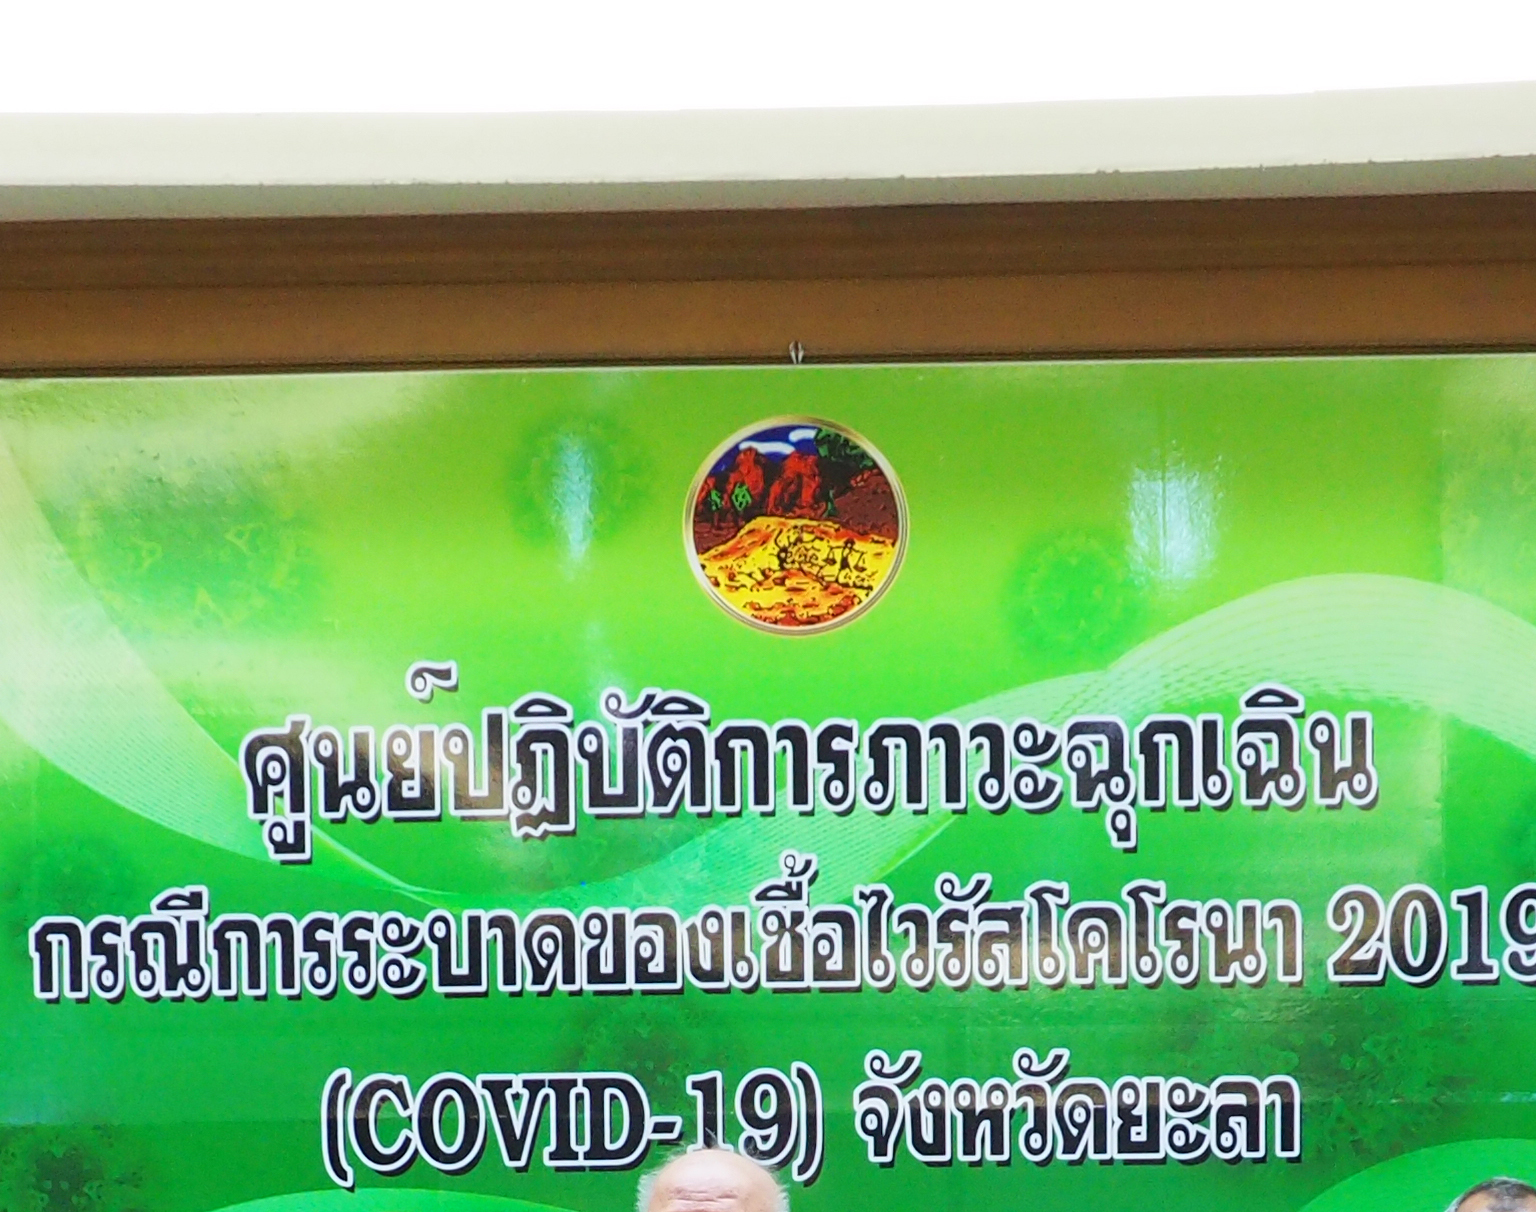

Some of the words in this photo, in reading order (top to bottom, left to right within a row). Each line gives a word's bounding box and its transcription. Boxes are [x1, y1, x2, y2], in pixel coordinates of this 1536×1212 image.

[241, 660, 1378, 861] ศูนย์ปฏิบัติการภาวะฉุกเฉิน
[30, 850, 1303, 999] กรณีการระบาดของเชื้อไวรัสโคโรนา
[321, 1064, 823, 1189] (COVID-19)
[854, 1048, 1302, 1164] จังหวัดยะลา
